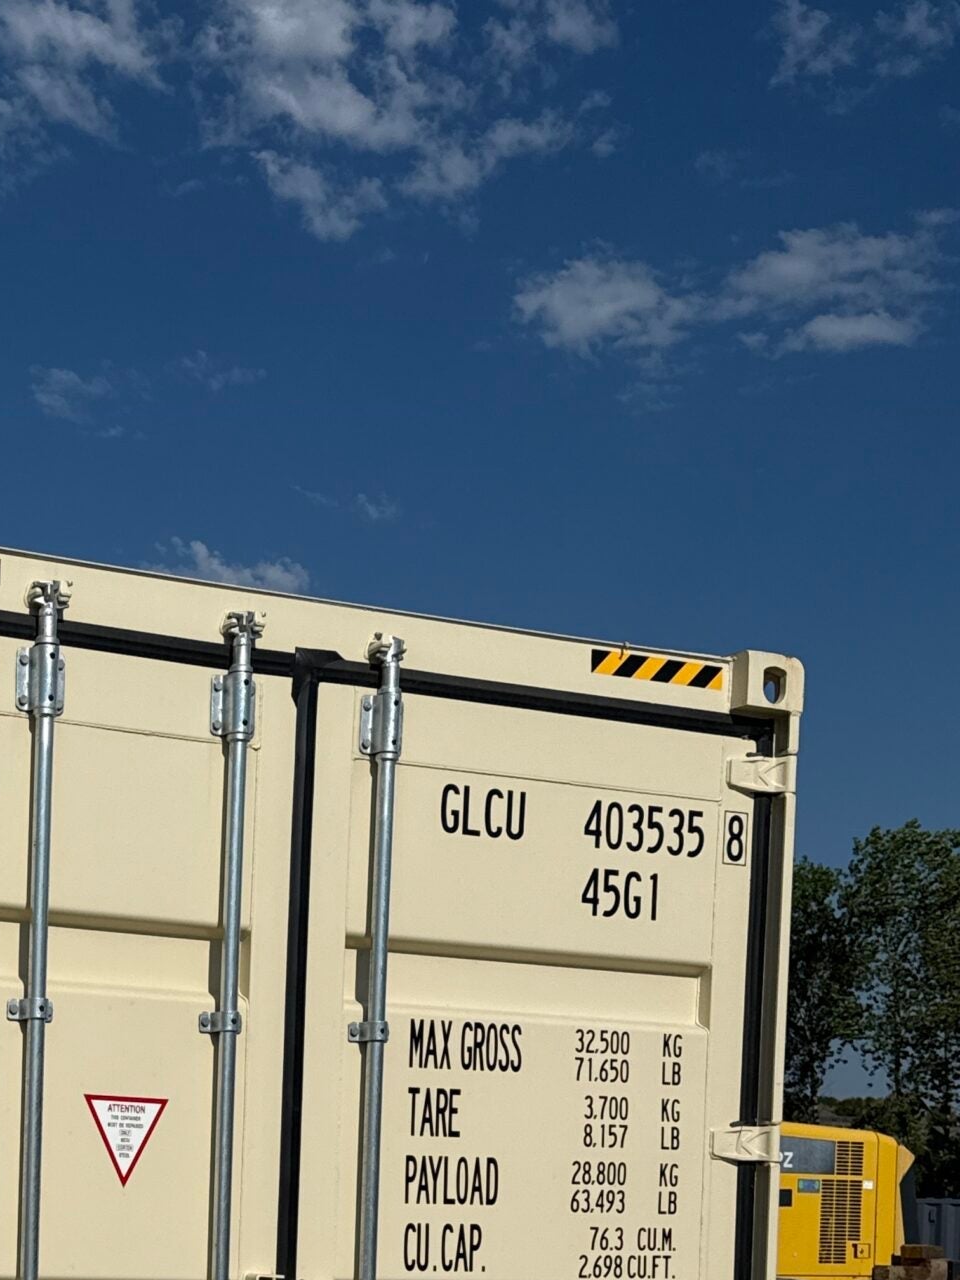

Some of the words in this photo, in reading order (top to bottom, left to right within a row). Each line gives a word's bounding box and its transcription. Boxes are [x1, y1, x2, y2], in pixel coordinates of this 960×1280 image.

[440, 783, 527, 841] GLCU
[583, 799, 705, 858] 403535
[726, 814, 744, 862] 8
[581, 867, 658, 921] 45G1
[408, 1018, 453, 1070] MAX
[460, 1021, 522, 1073] GROSS
[662, 1033, 683, 1059] KG
[661, 1061, 681, 1086] LB
[107, 1103, 146, 1114] ATTENTION
[407, 1086, 462, 1138] TARE
[661, 1098, 680, 1123] KG
[660, 1126, 680, 1151] LB
[404, 1154, 499, 1206] PAYLOAD
[659, 1163, 679, 1188] KG
[657, 1191, 677, 1215] LB
[589, 1226, 624, 1251] 76.3
